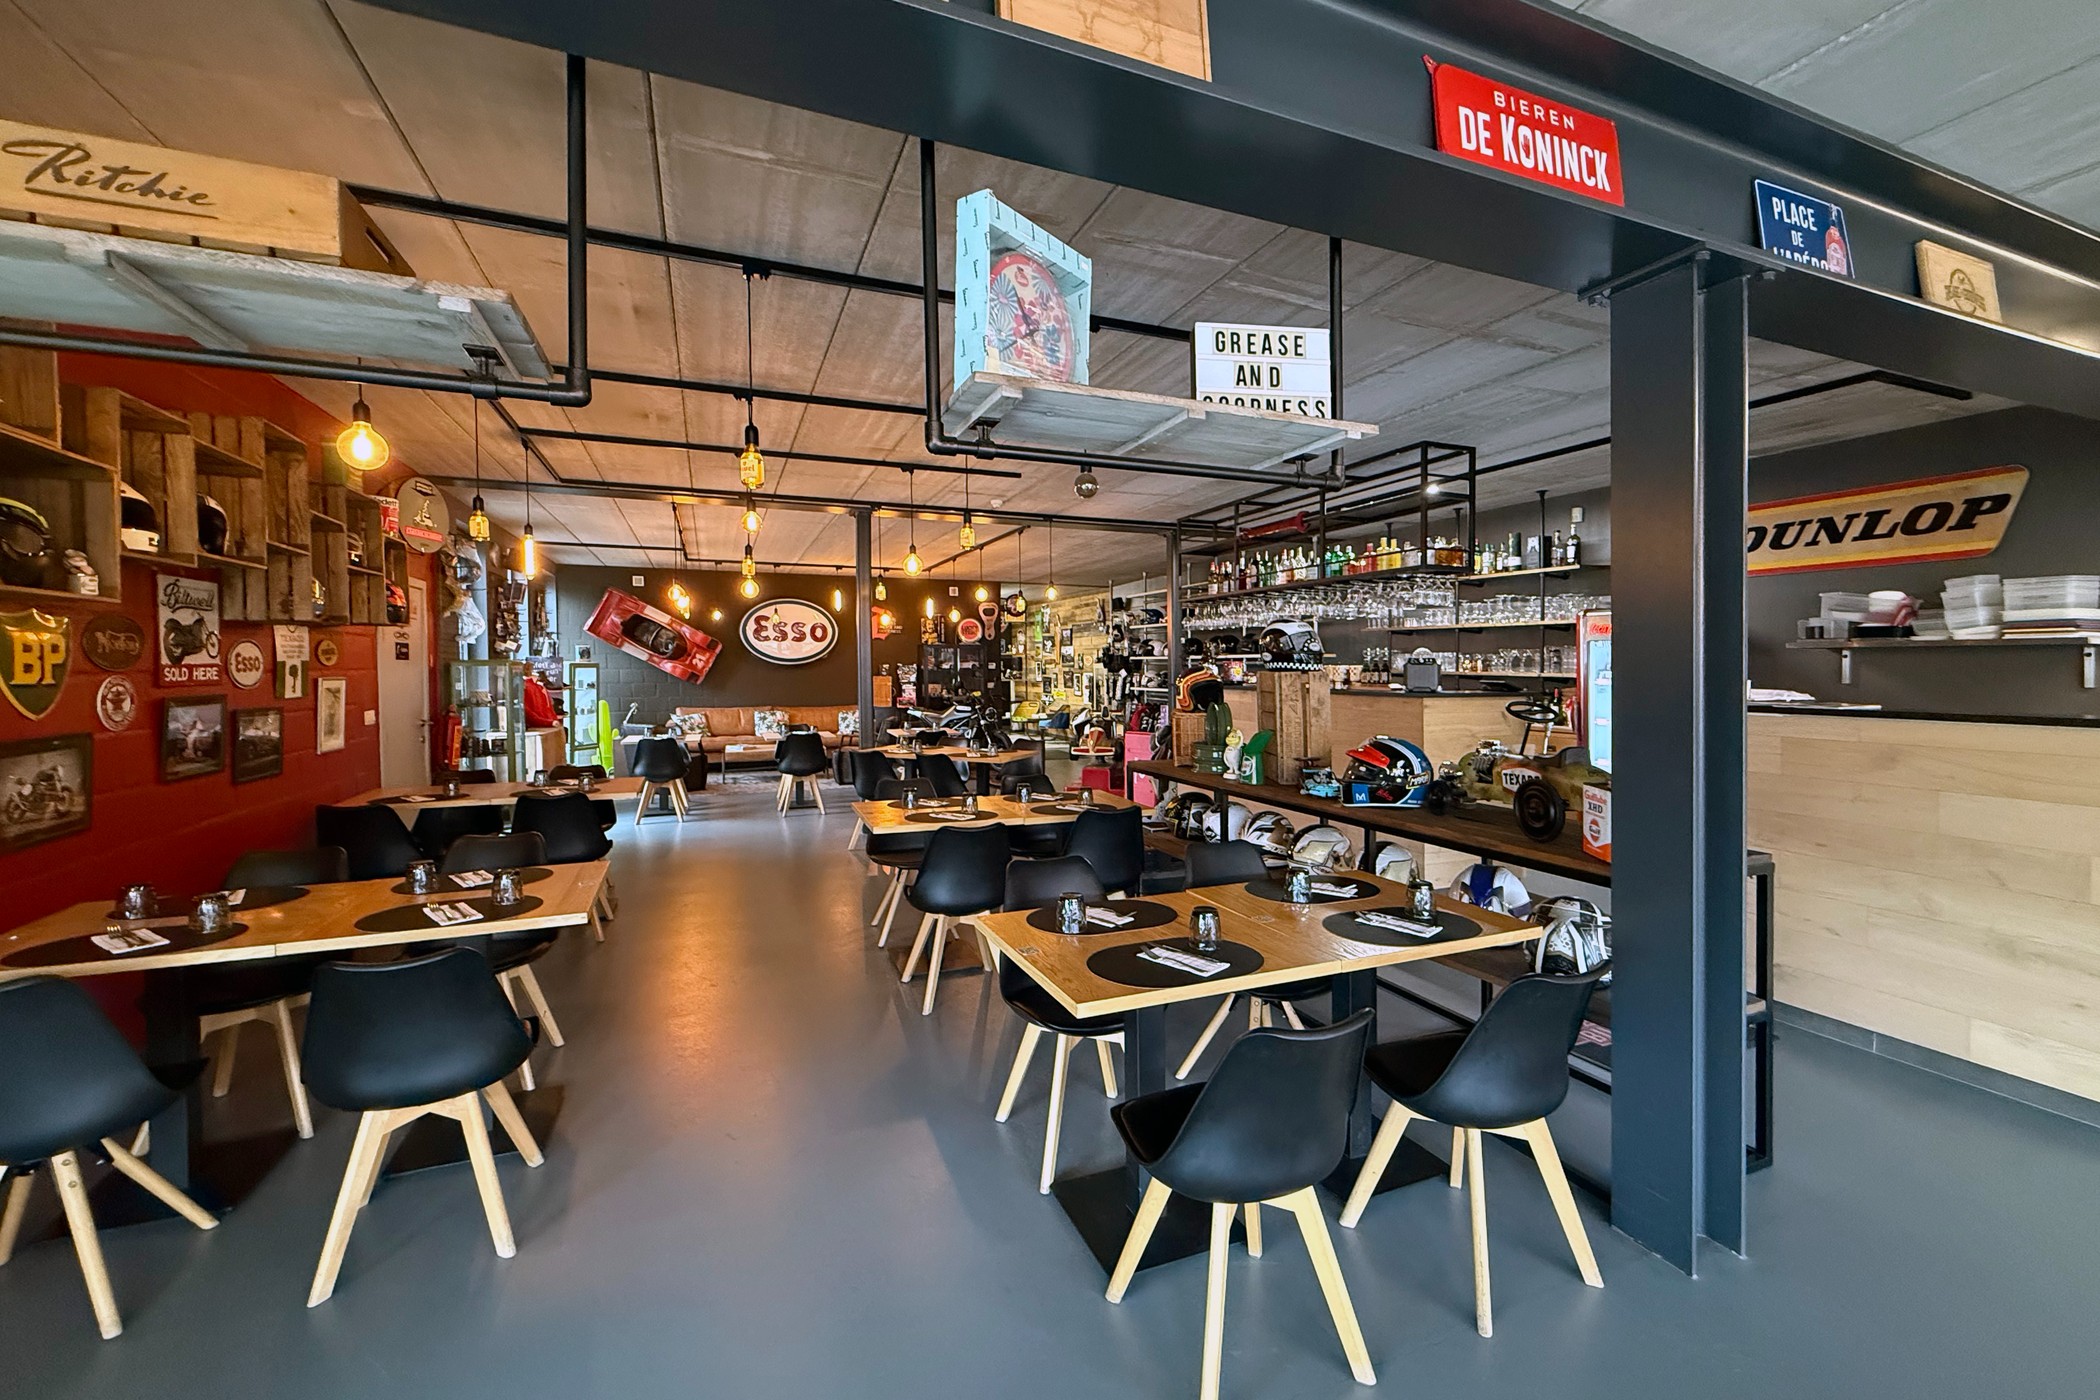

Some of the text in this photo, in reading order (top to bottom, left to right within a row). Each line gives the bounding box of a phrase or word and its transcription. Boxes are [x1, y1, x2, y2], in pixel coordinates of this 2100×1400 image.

[1493, 90, 1575, 131] BIEREN
[1458, 105, 1611, 192] DE KONINCK
[2, 140, 217, 206] Ritchie
[1771, 196, 1818, 232] PLACE
[1790, 229, 1804, 248] DE
[1215, 330, 1304, 357] GREASE
[1235, 364, 1281, 388] AND
[1202, 395, 1326, 419] NESS
[9, 632, 67, 685] BP
[164, 667, 220, 681] SOLD HERE
[1503, 773, 1541, 785] TEXA
